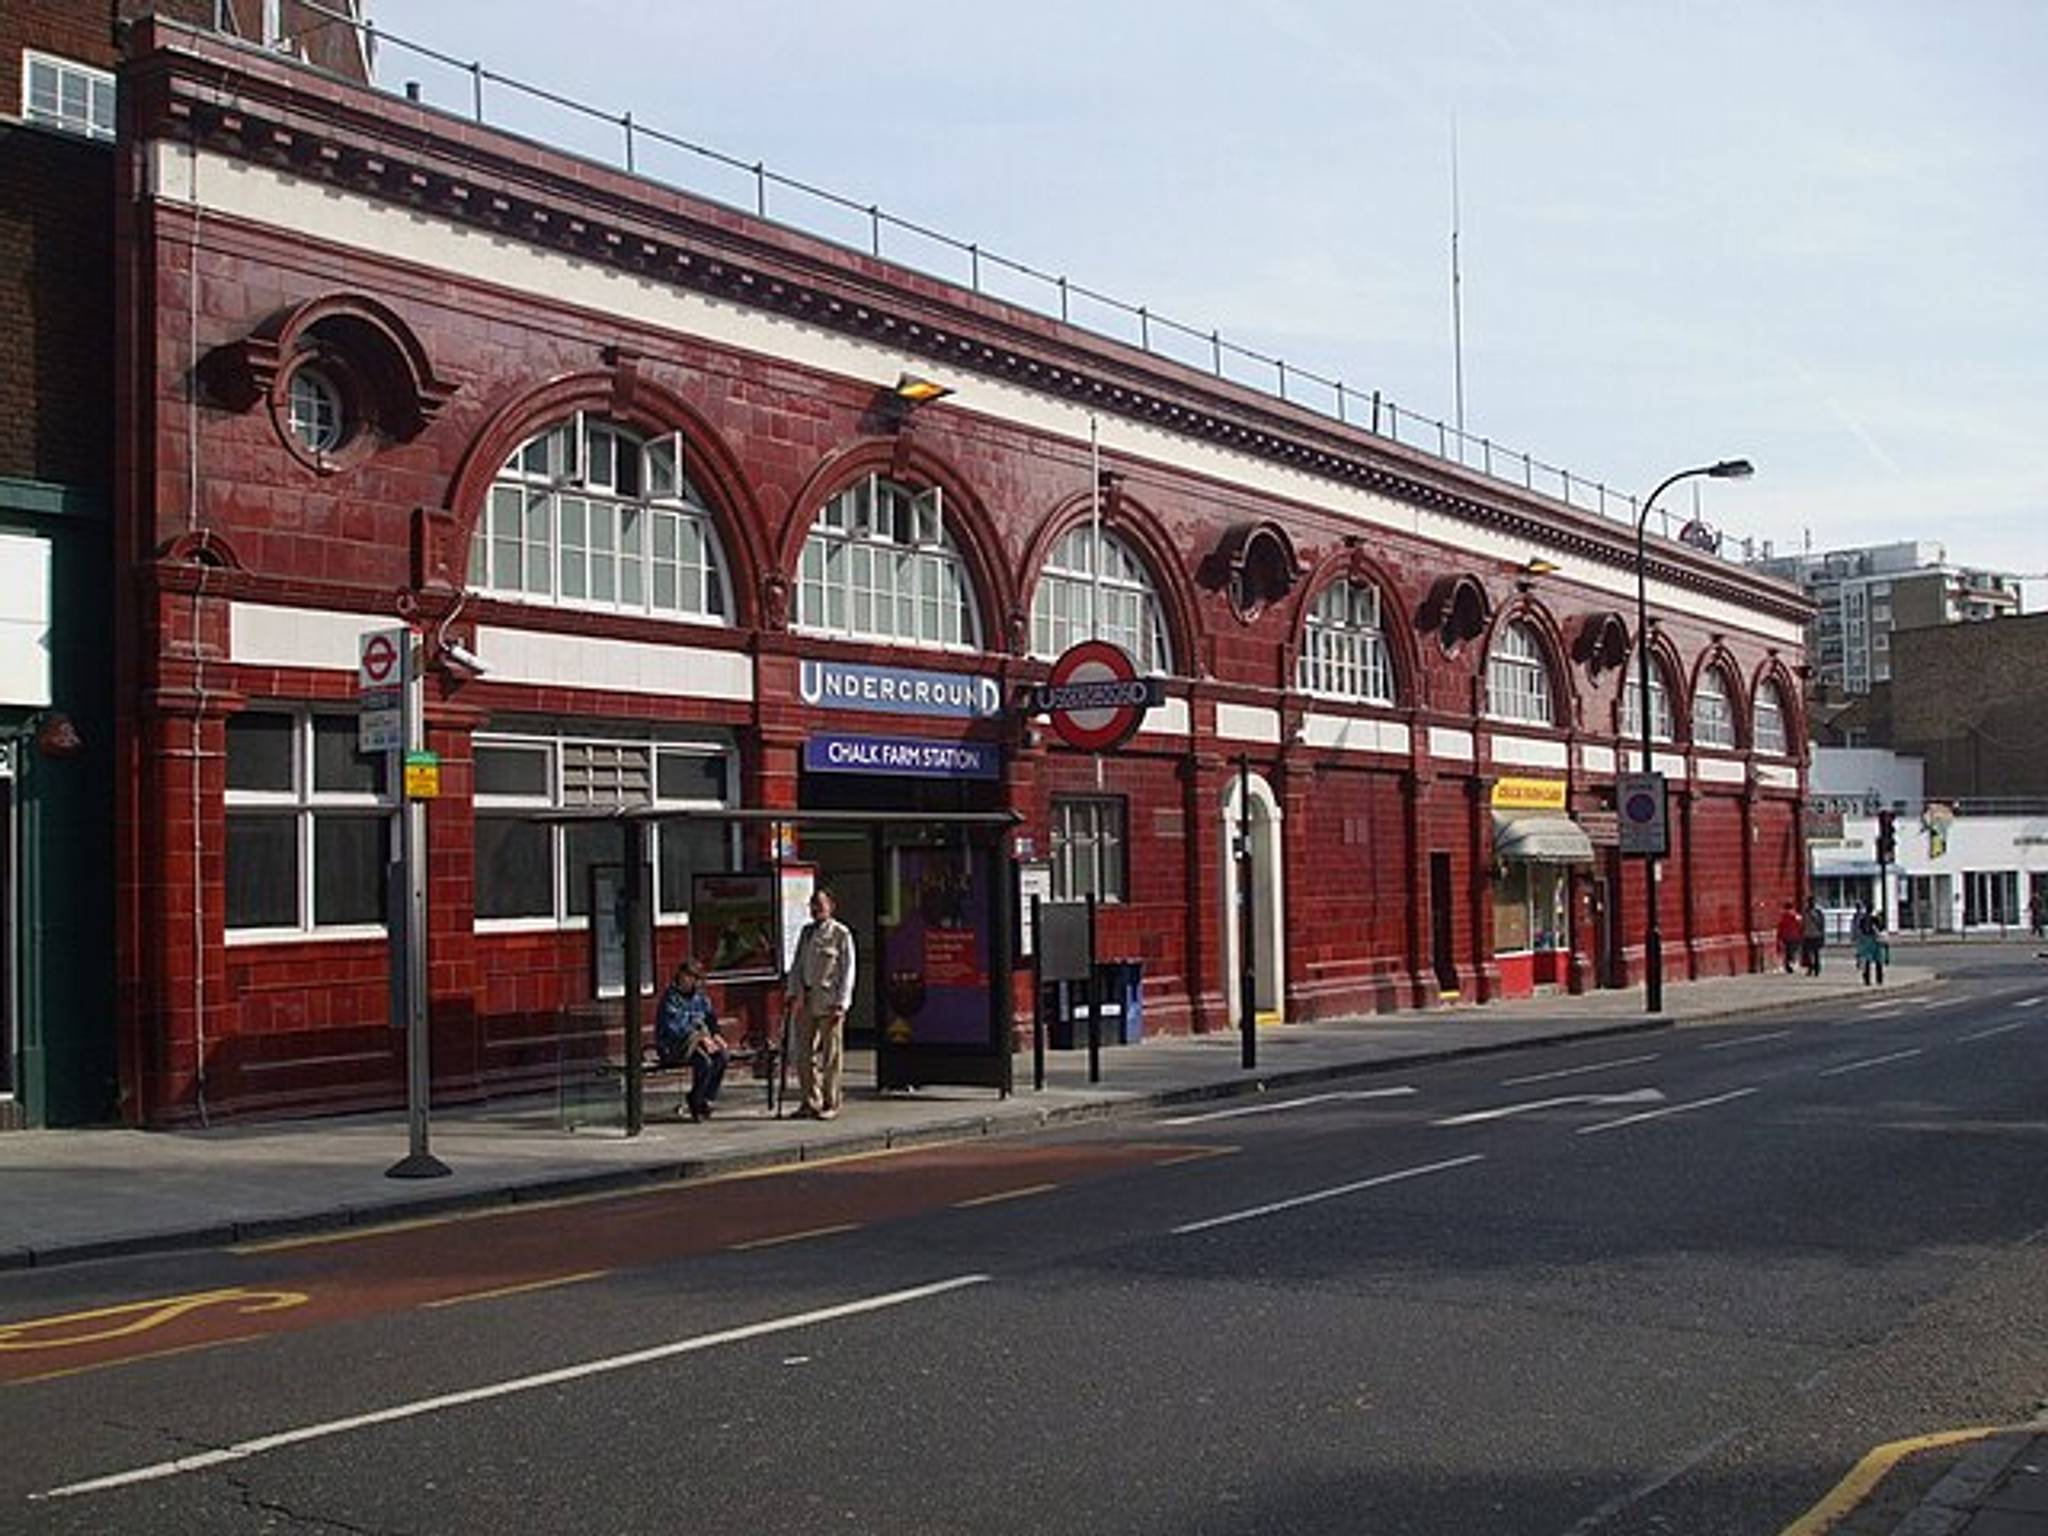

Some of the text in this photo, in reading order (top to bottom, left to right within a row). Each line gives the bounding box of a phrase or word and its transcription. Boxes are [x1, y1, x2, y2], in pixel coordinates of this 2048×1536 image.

[799, 660, 1000, 716] UNDERGROUND
[828, 741, 981, 770] CHALK FARM STATION
